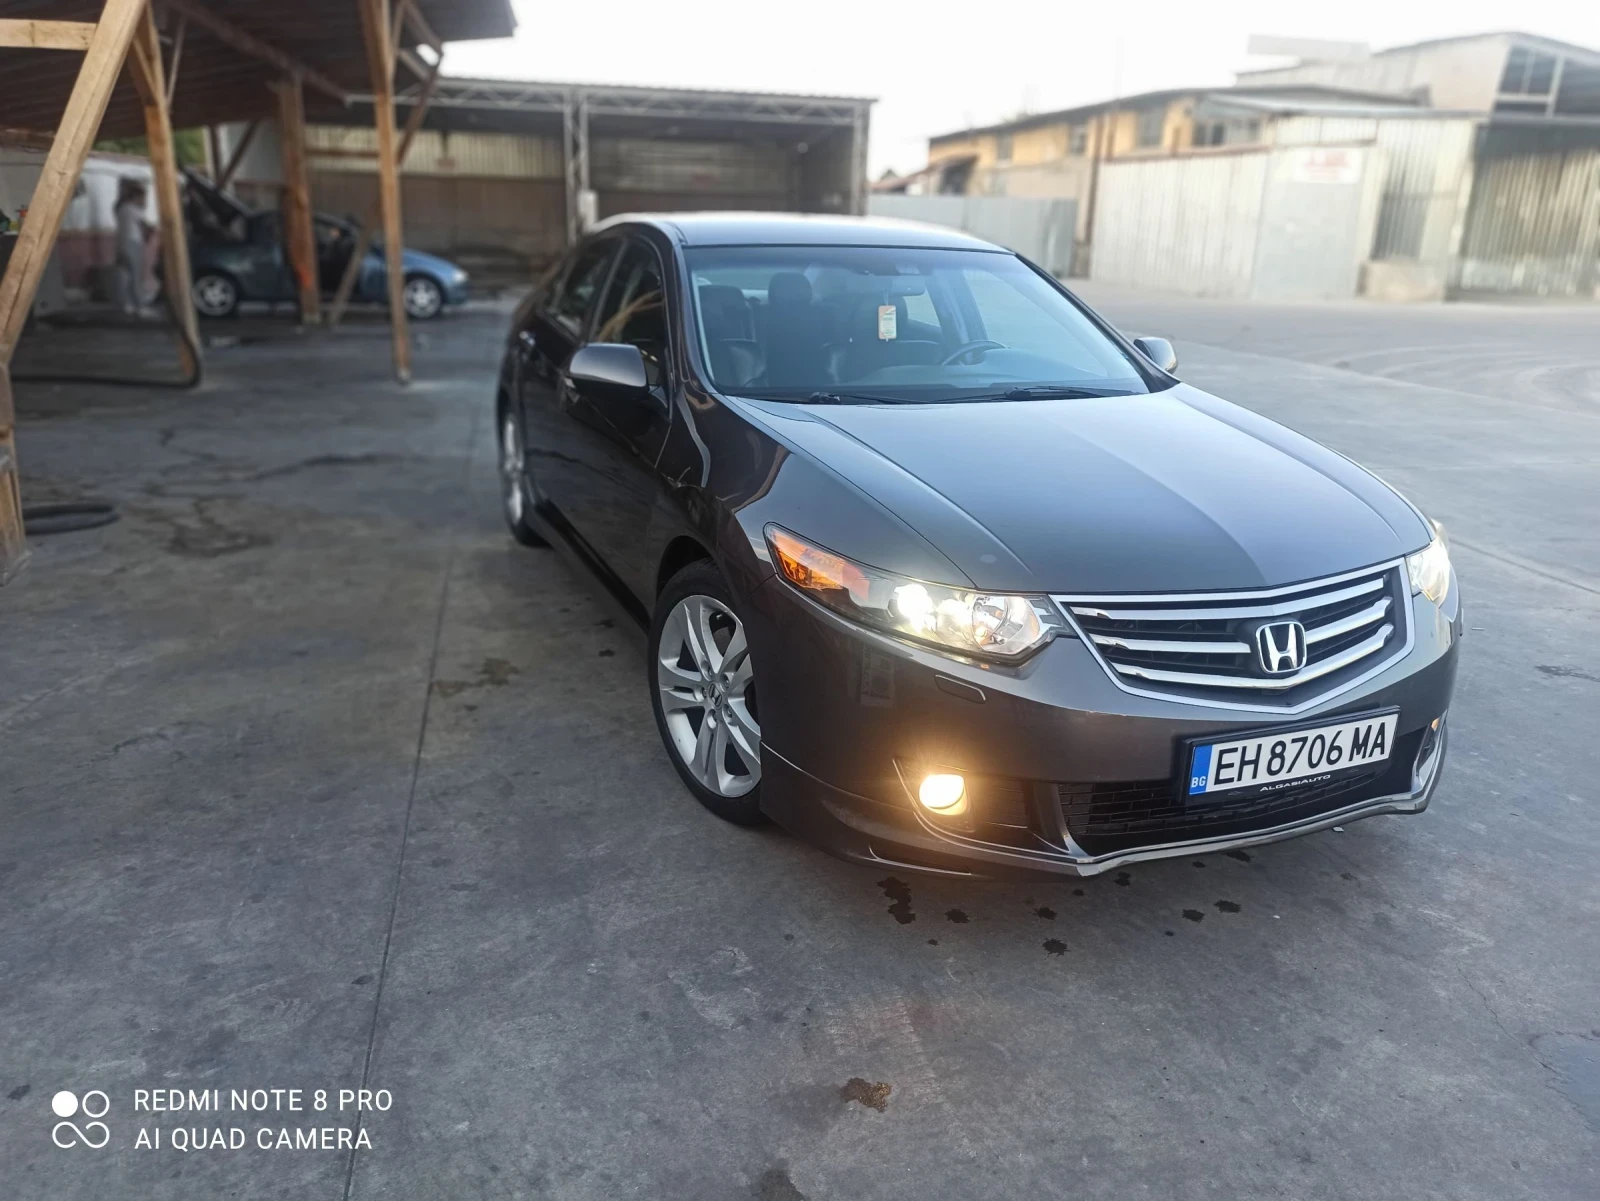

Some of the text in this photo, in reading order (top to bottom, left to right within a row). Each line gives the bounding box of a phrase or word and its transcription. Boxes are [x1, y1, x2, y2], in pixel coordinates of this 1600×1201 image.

[1214, 722, 1386, 785] EH 8706 MA
[1190, 775, 1207, 788] BG
